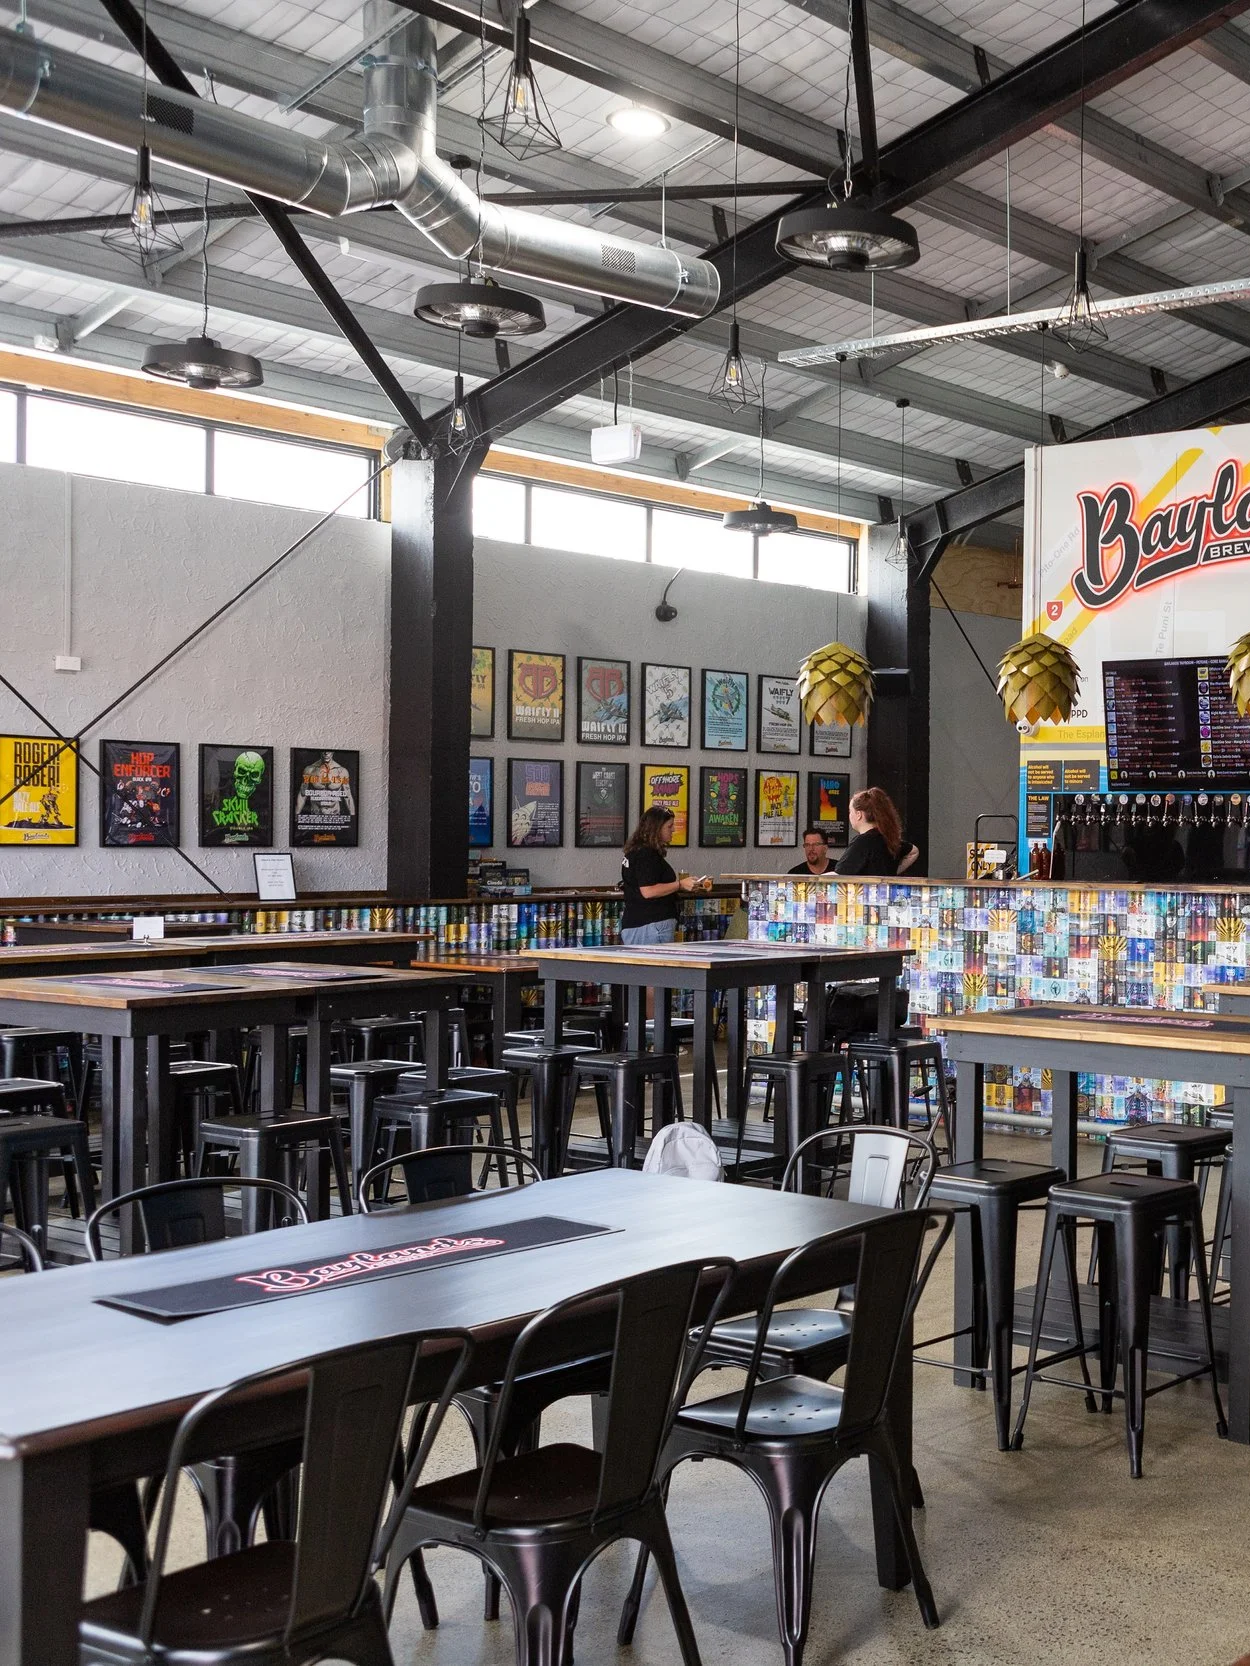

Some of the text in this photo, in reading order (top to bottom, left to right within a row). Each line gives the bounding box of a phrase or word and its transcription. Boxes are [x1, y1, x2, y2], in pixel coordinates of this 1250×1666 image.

[1051, 605, 1058, 616] 2
[1159, 616, 1169, 640] Puni
[1164, 601, 1172, 613] St
[1062, 627, 1078, 647] oad
[769, 687, 794, 697] WAIFLY
[515, 706, 551, 717] WAIFLY
[582, 721, 617, 733] WAIFLY
[582, 732, 602, 740] FRESH
[1058, 729, 1074, 740] The
[14, 741, 60, 765] ROGER!
[131, 752, 154, 765] HOP
[114, 763, 171, 778] ENFORCER
[650, 775, 681, 785] OFFSHORE
[212, 810, 259, 826] CRACKER
[709, 813, 739, 824] AWAKEN
[236, 1237, 506, 1293] Baylands
